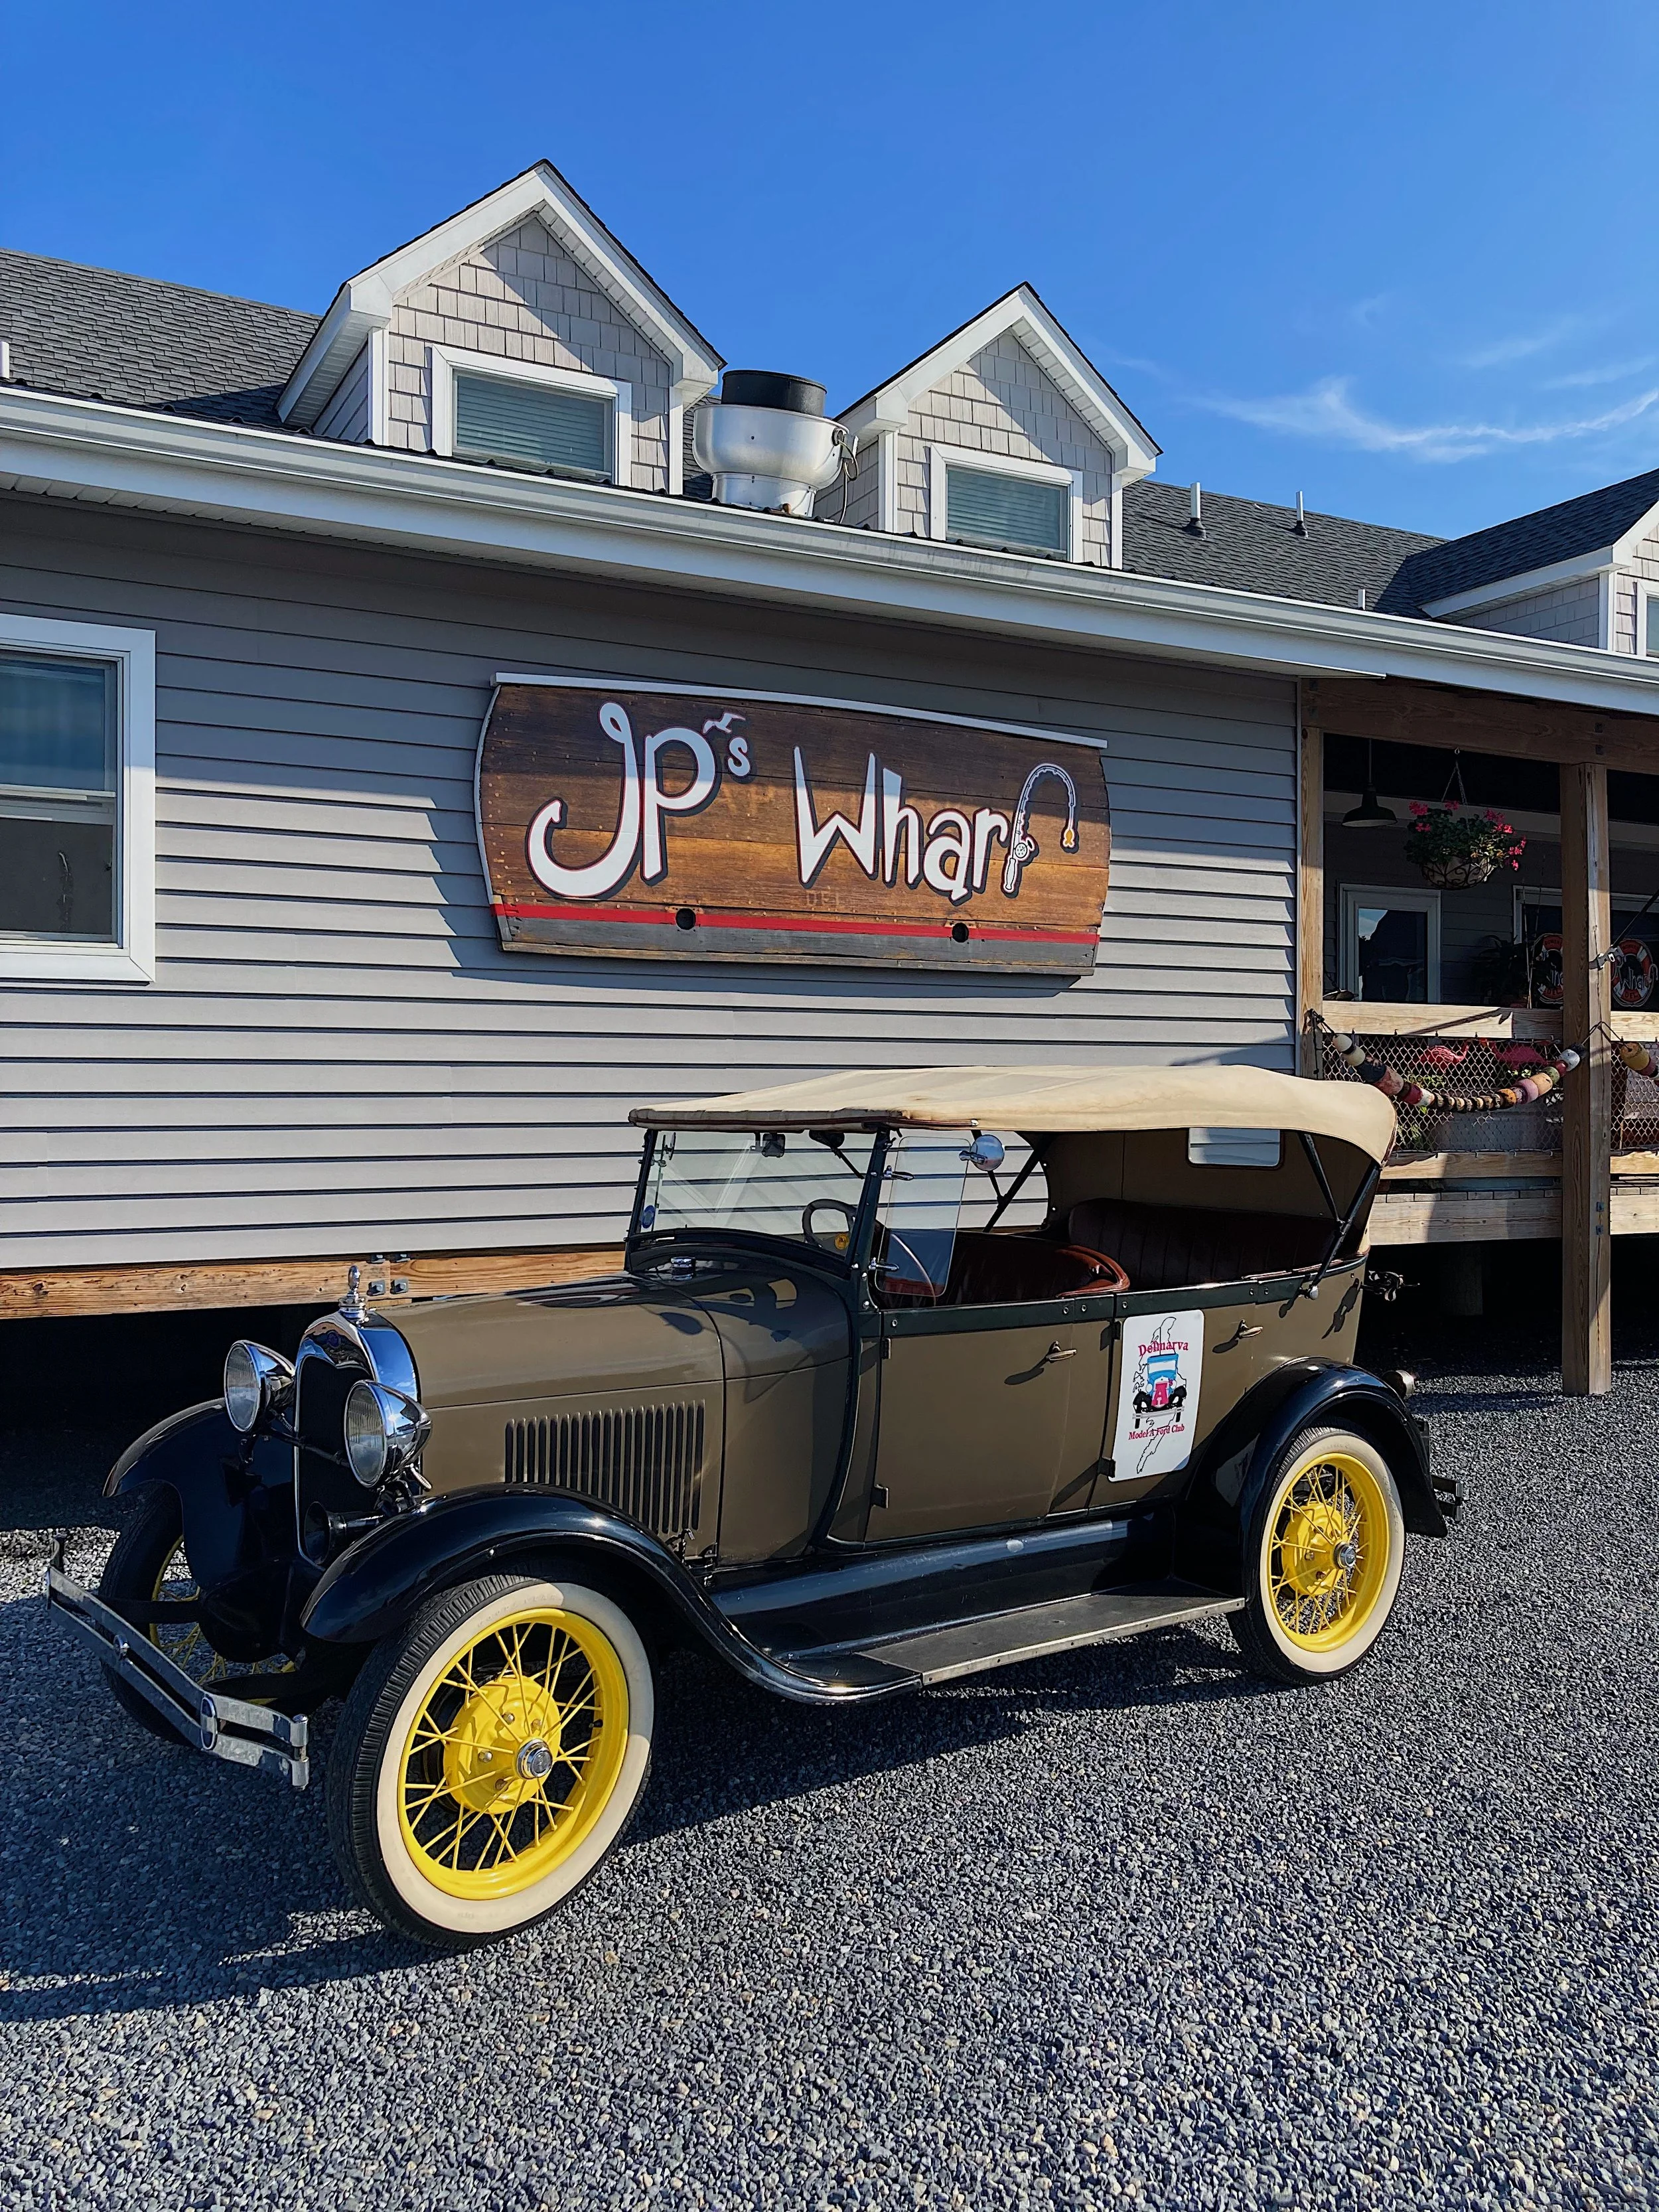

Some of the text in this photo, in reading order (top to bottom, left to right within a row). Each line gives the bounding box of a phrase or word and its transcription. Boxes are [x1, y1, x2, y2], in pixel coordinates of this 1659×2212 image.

[1138, 1341, 1189, 1357] Delmarva
[1128, 1430, 1148, 1439] Model
[1157, 1426, 1170, 1436] Ford
[1171, 1424, 1185, 1433] Club
